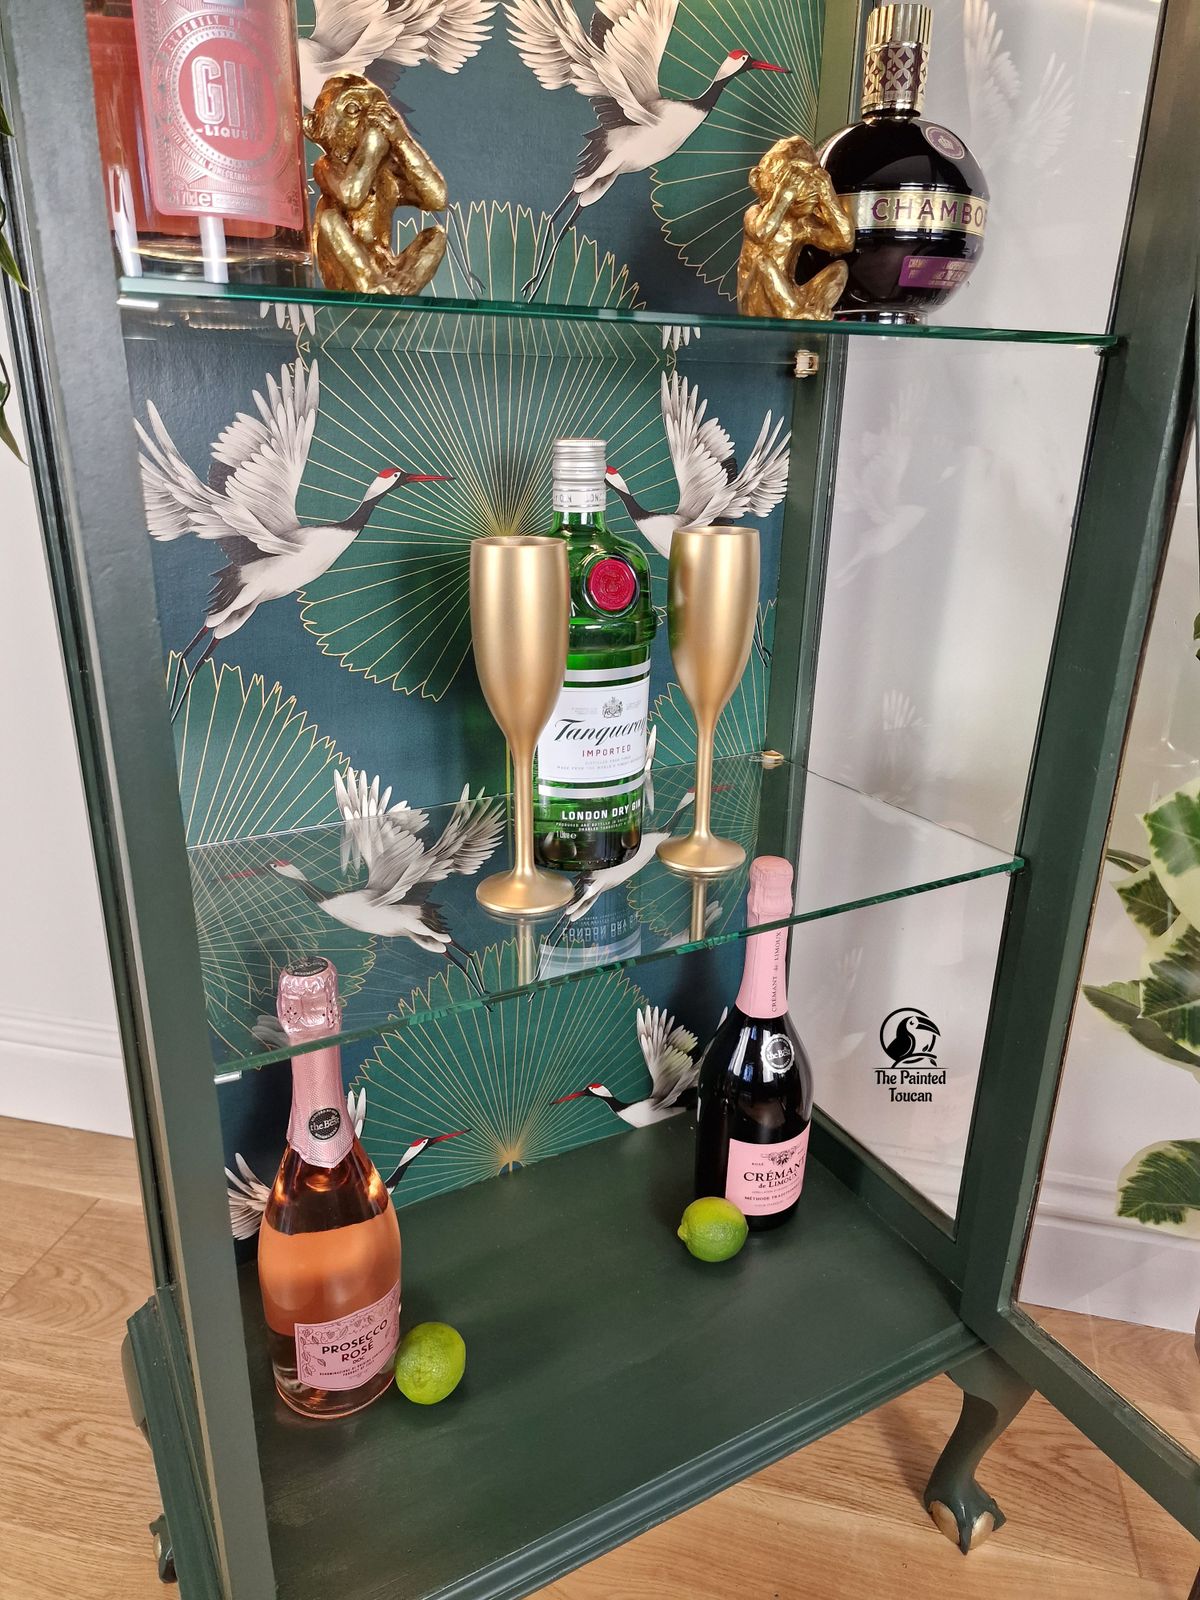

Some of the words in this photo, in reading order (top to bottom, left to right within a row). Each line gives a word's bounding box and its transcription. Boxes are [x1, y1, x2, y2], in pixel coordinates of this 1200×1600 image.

[165, 15, 220, 51] EXPERTLY
[582, 744, 632, 758] IMPORTED
[561, 809, 608, 821] LONDON
[612, 805, 629, 818] DRY
[774, 931, 782, 961] LIMOUX
[874, 1070, 897, 1085] The
[900, 1069, 946, 1085] Painted
[889, 1087, 932, 1102] Toucan
[322, 1319, 388, 1355] PROSECCO
[341, 1338, 374, 1363] ROSÉ
